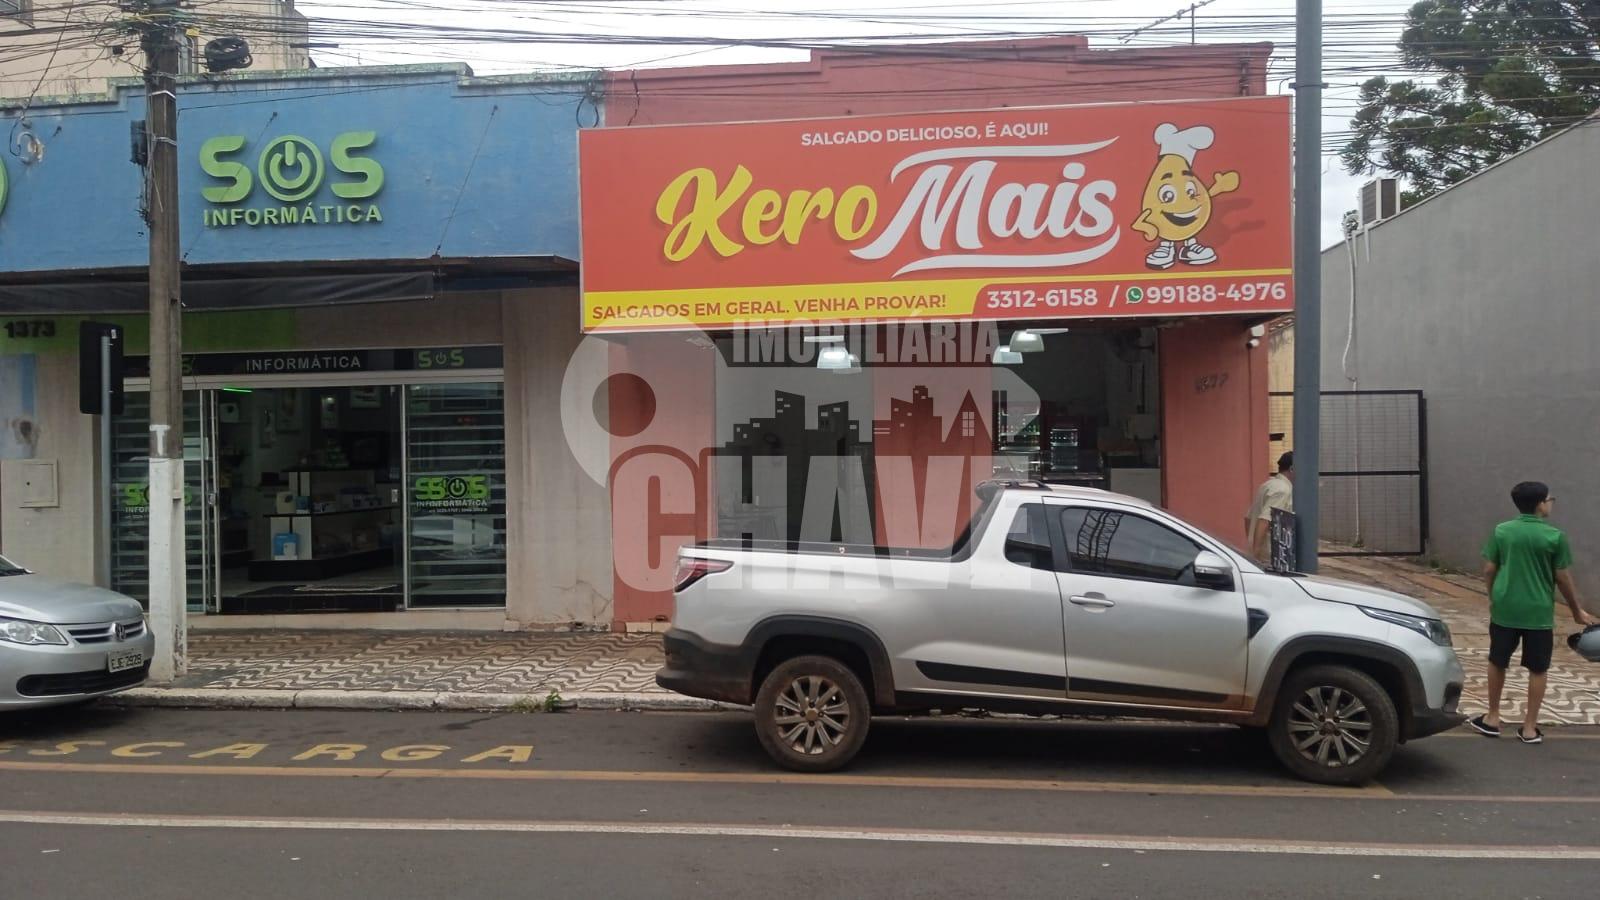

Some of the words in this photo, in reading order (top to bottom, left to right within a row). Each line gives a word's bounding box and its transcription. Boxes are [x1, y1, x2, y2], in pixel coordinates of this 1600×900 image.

[801, 129, 883, 146] SALGADO
[886, 125, 982, 142] DELICIOSO,
[985, 121, 996, 138] É
[1000, 122, 1049, 139] AQUI!
[200, 131, 384, 203] SOS
[203, 202, 383, 227] INFORMÁTICA
[655, 164, 878, 262] Kero
[849, 158, 1118, 262] Mais
[592, 304, 690, 320] SALGADOS
[695, 302, 721, 316] EM
[726, 301, 790, 316] GERAL.
[794, 297, 860, 313] VENHA
[864, 294, 946, 310] PROVAR!
[987, 288, 1098, 309] 3312-6158
[1147, 282, 1286, 304] 99188-4976
[3, 320, 56, 338] 1373
[246, 354, 361, 371] INFORMÁTICA
[418, 350, 465, 368] SOS
